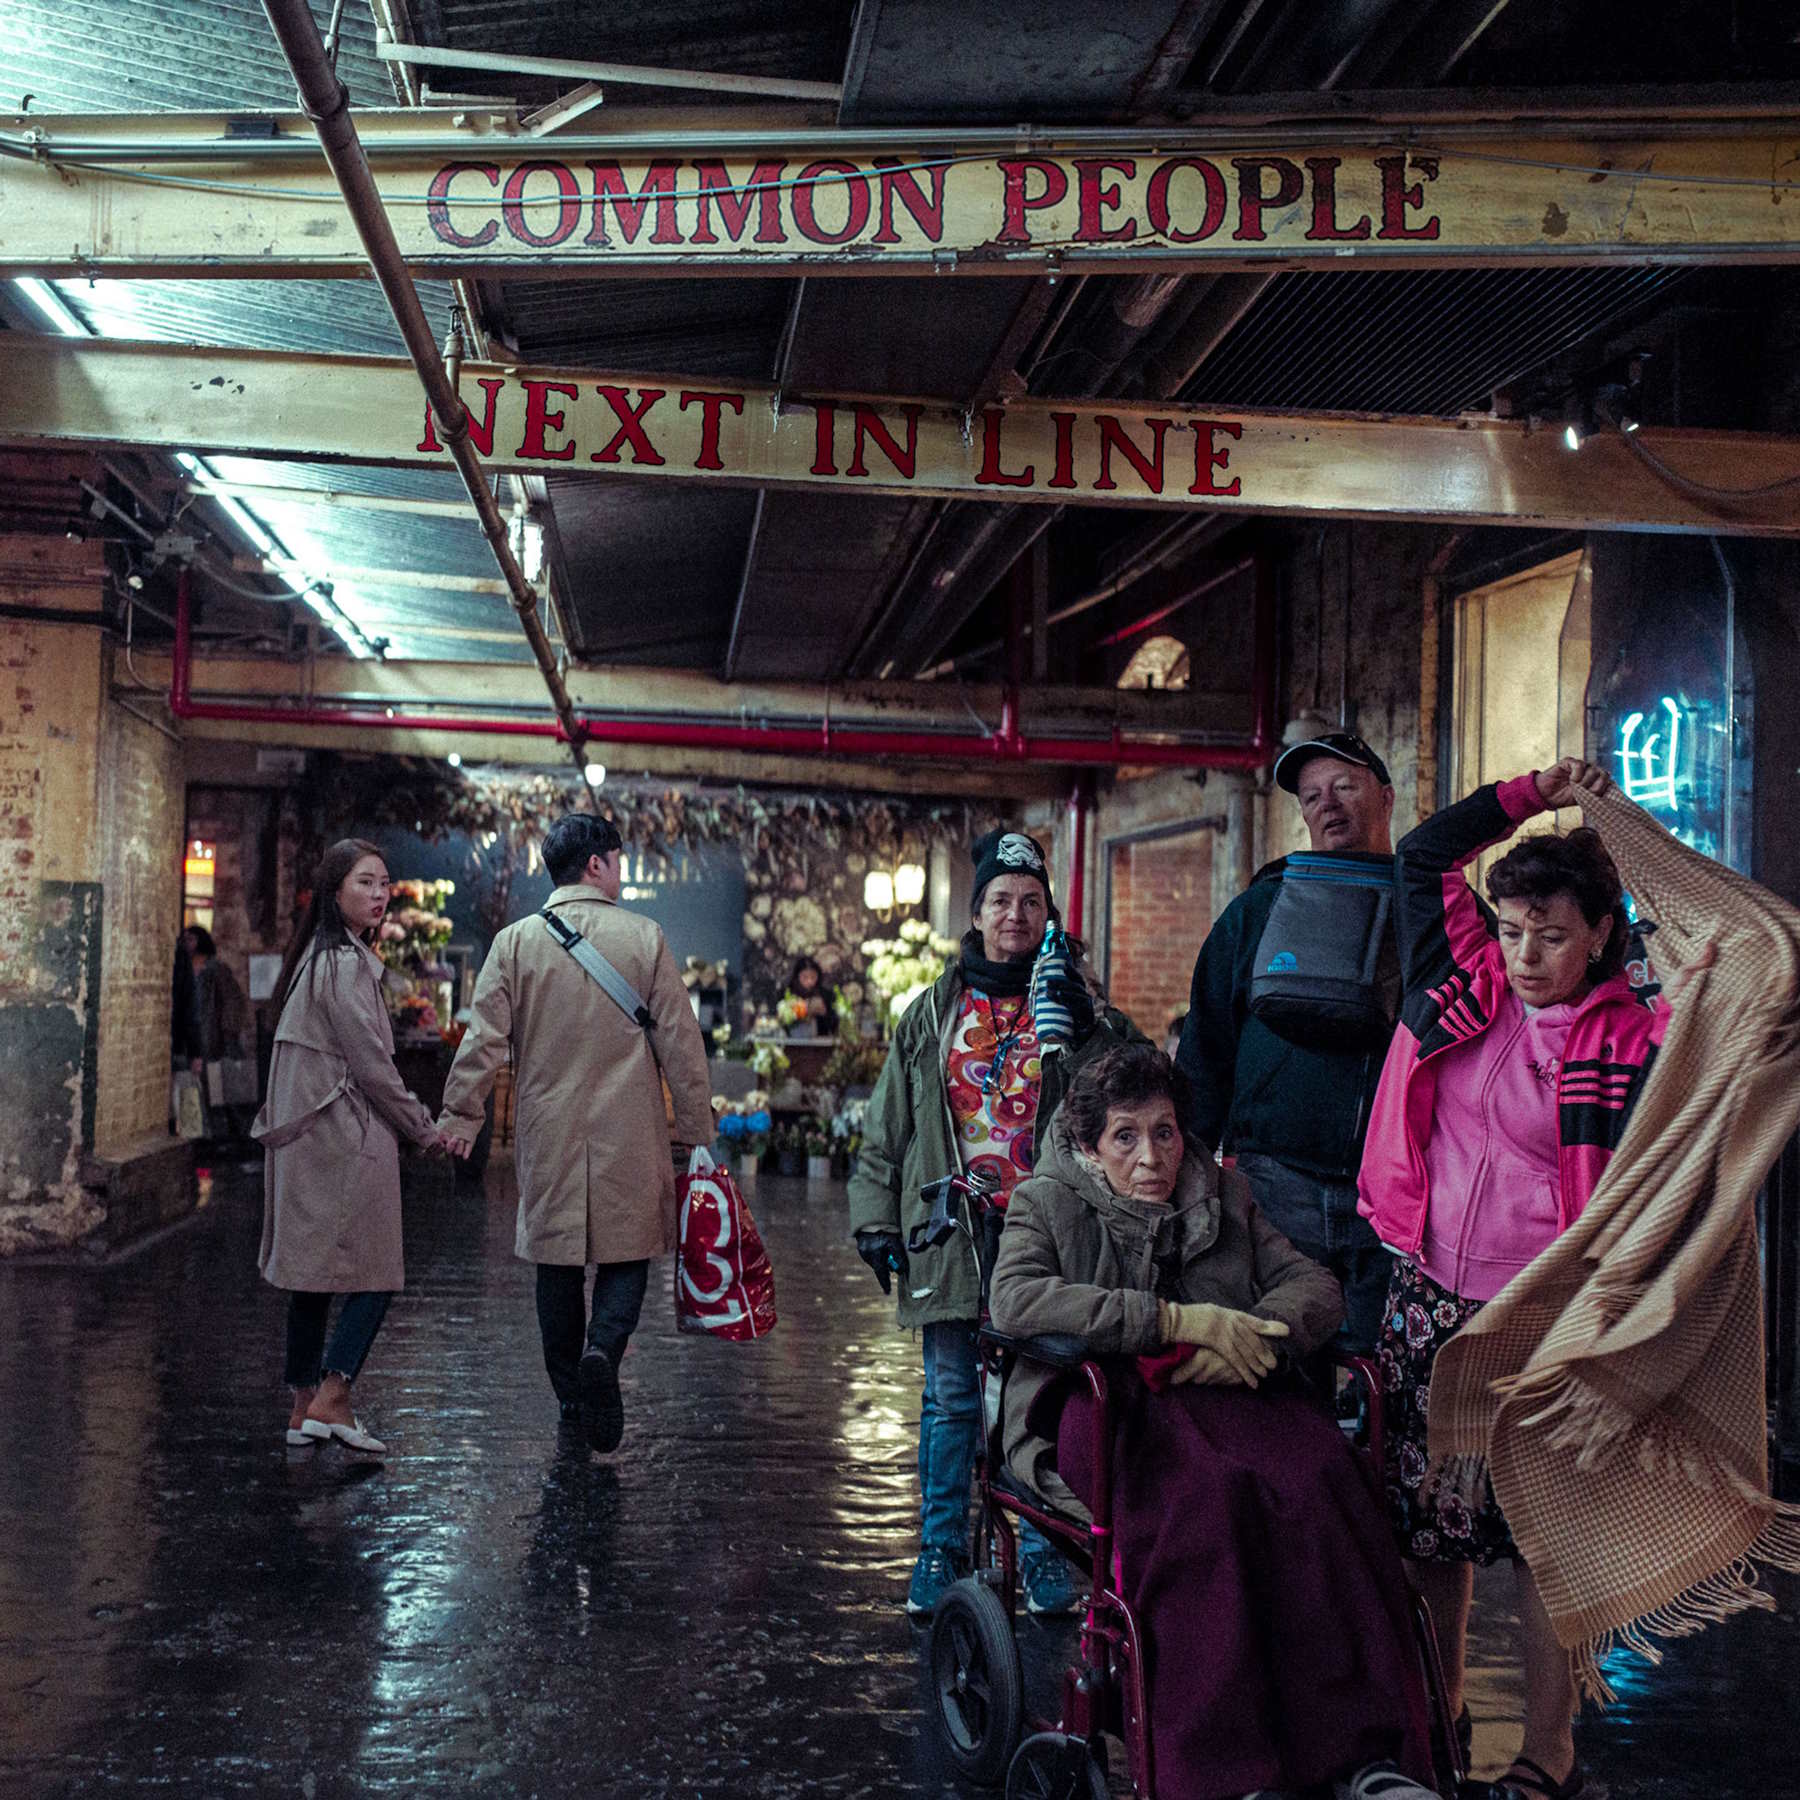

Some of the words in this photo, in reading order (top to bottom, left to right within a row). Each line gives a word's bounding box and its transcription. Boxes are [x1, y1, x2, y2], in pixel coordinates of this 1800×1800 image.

[427, 158, 952, 248] COMMON
[999, 157, 1440, 243] PEOPLE
[417, 378, 744, 471] NEXT
[809, 399, 923, 479] IN
[975, 409, 1242, 497] LINE
